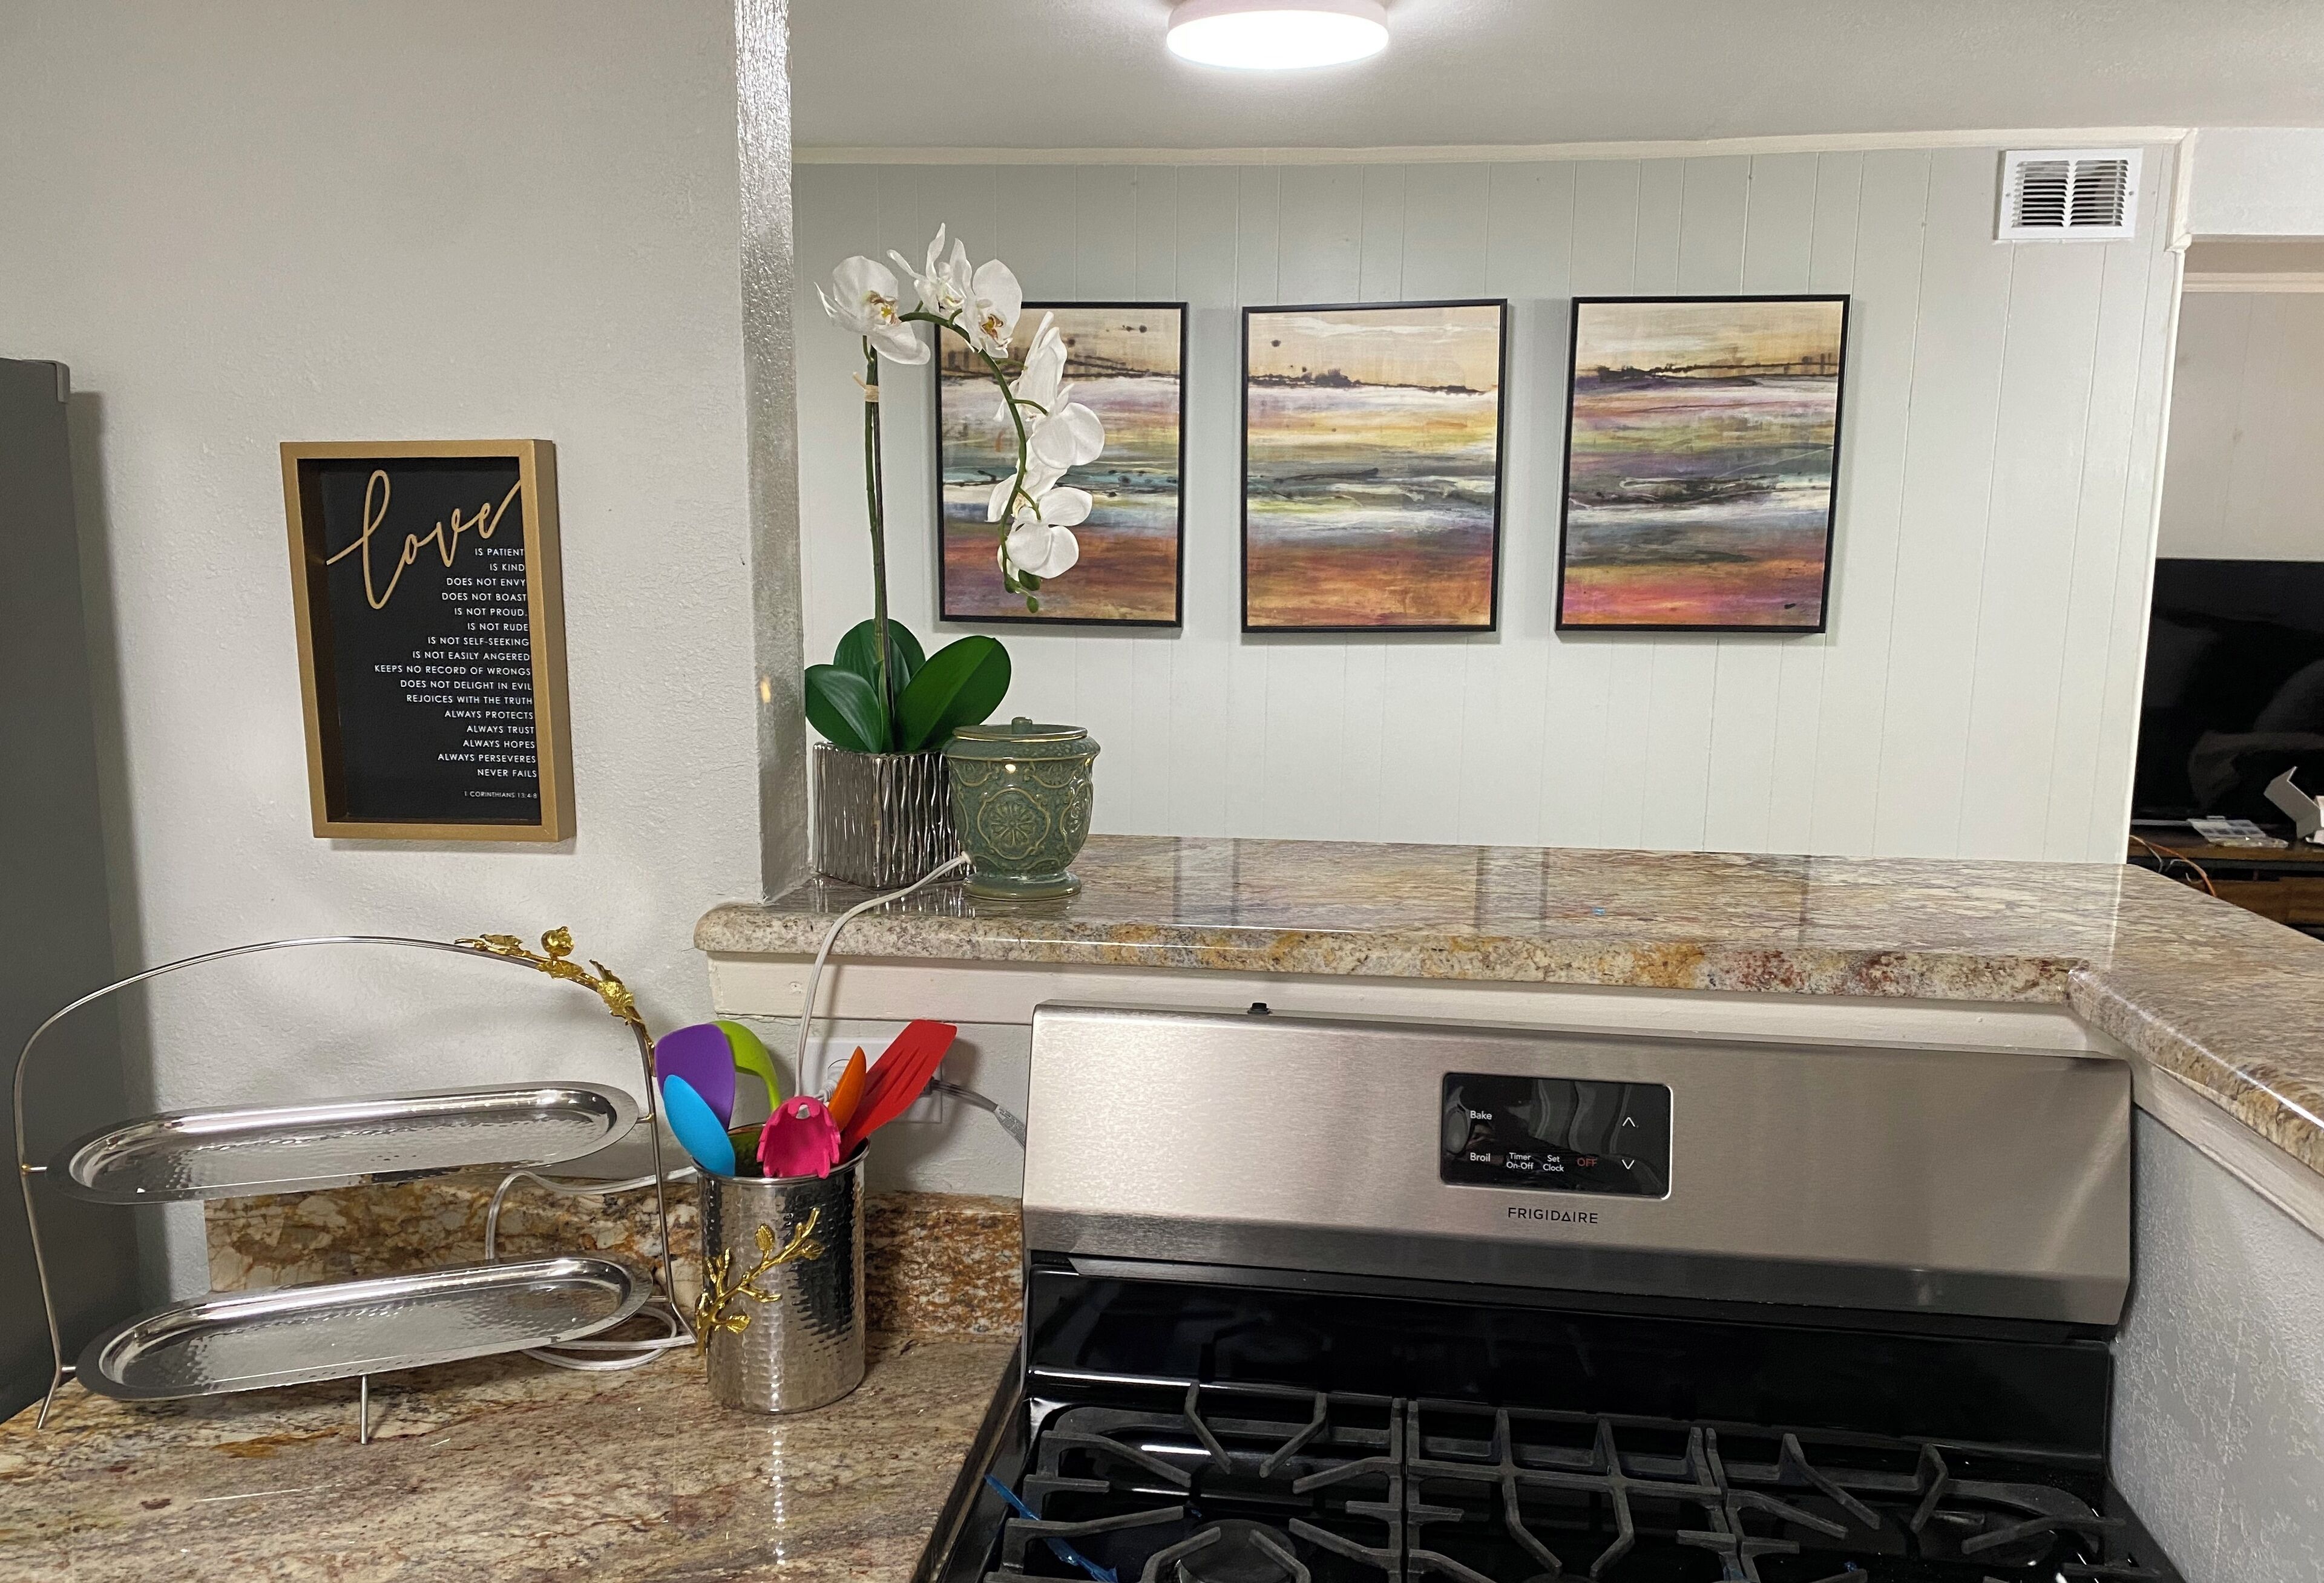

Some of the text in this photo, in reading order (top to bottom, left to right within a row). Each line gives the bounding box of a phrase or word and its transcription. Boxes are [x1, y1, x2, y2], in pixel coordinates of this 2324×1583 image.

[326, 469, 521, 609] love
[463, 637, 530, 646] SELF-SEEKING
[487, 667, 531, 676] WRONGS
[512, 682, 532, 691] EVIL
[406, 694, 453, 703] REJOICES
[484, 696, 501, 704] THE
[504, 696, 533, 705] TRUTH
[485, 711, 533, 719] PROTECTS
[467, 725, 504, 733] ALWAYS
[462, 739, 500, 748] ALWAYS
[479, 754, 536, 763] PERSEVERES
[477, 769, 537, 778] NEVER FAILS
[1469, 1110, 1492, 1120] Bake
[1469, 1152, 1491, 1162] Broil
[1547, 1155, 1560, 1163] Set
[1506, 1161, 1534, 1170] On-Off
[1577, 1157, 1598, 1167] OFF
[1508, 1207, 1598, 1224] FRIGIDAIRE
